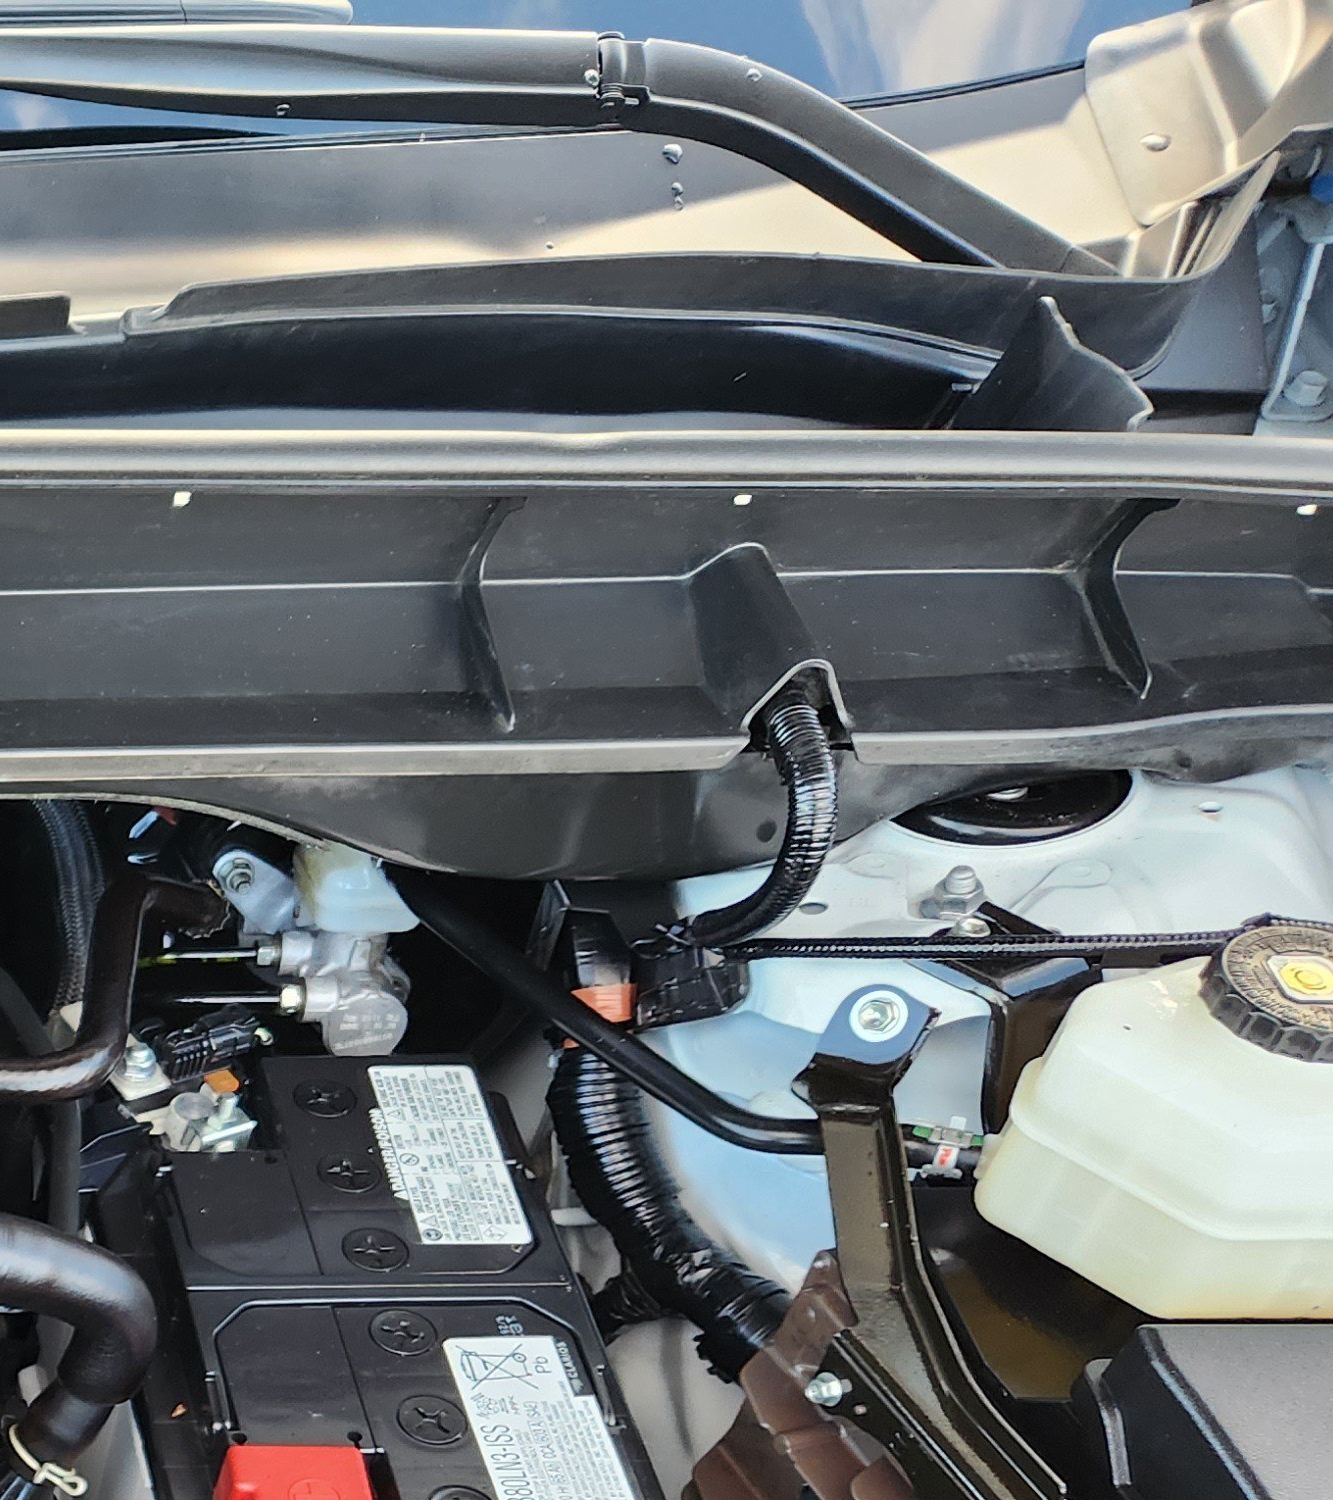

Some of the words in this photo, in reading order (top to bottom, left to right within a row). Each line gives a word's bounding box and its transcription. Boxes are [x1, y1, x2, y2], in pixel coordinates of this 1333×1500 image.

[368, 1107, 407, 1190] DANGER/POISON
[535, 1356, 552, 1375] Pb
[556, 1341, 579, 1380] CLARIOS
